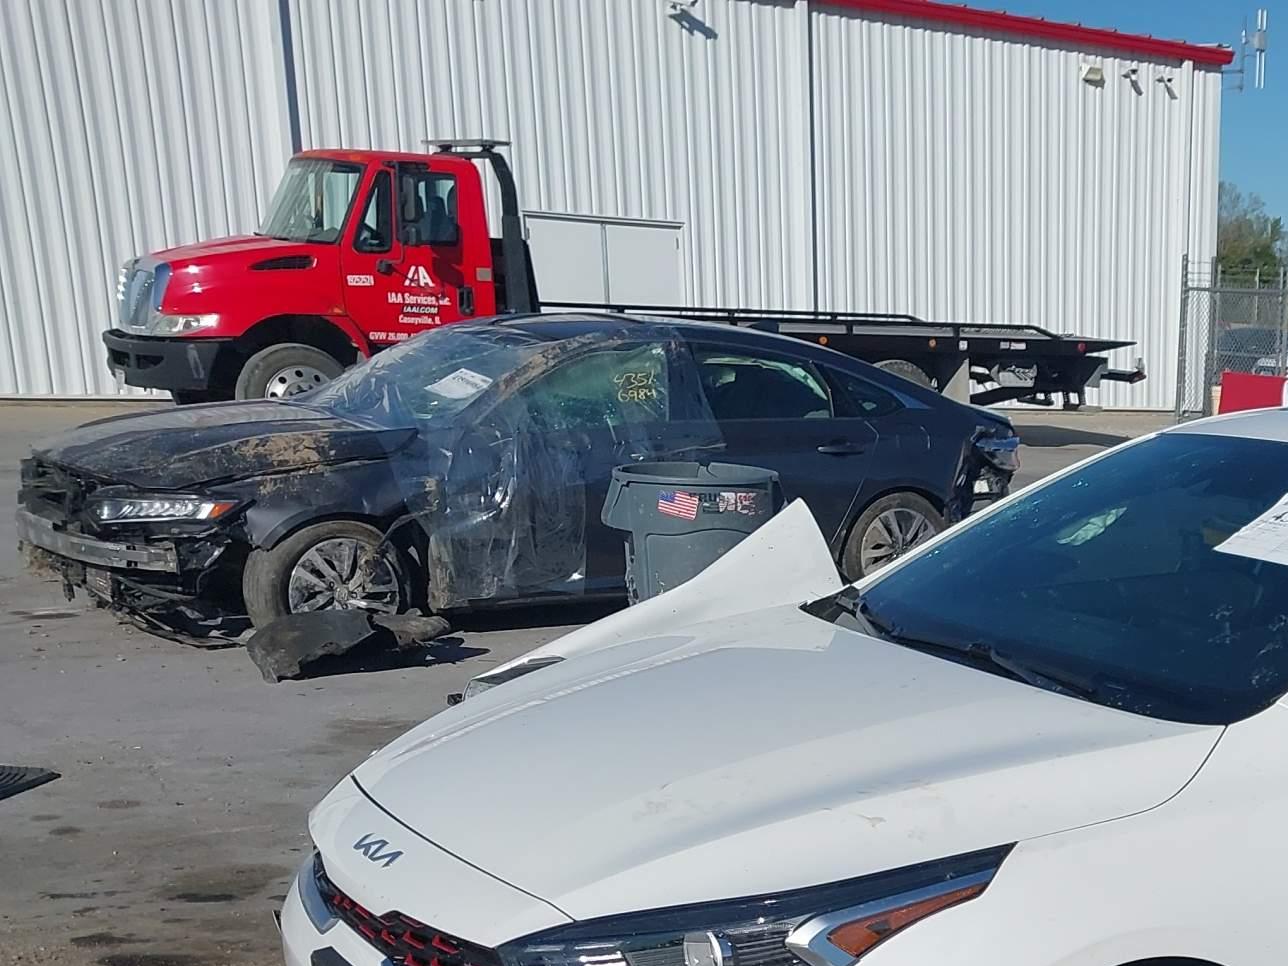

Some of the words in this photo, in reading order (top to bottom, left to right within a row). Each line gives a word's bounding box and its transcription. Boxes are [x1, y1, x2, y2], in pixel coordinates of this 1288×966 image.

[388, 292, 403, 303] IAA
[613, 369, 656, 389] 4351
[618, 388, 657, 403] 6984
